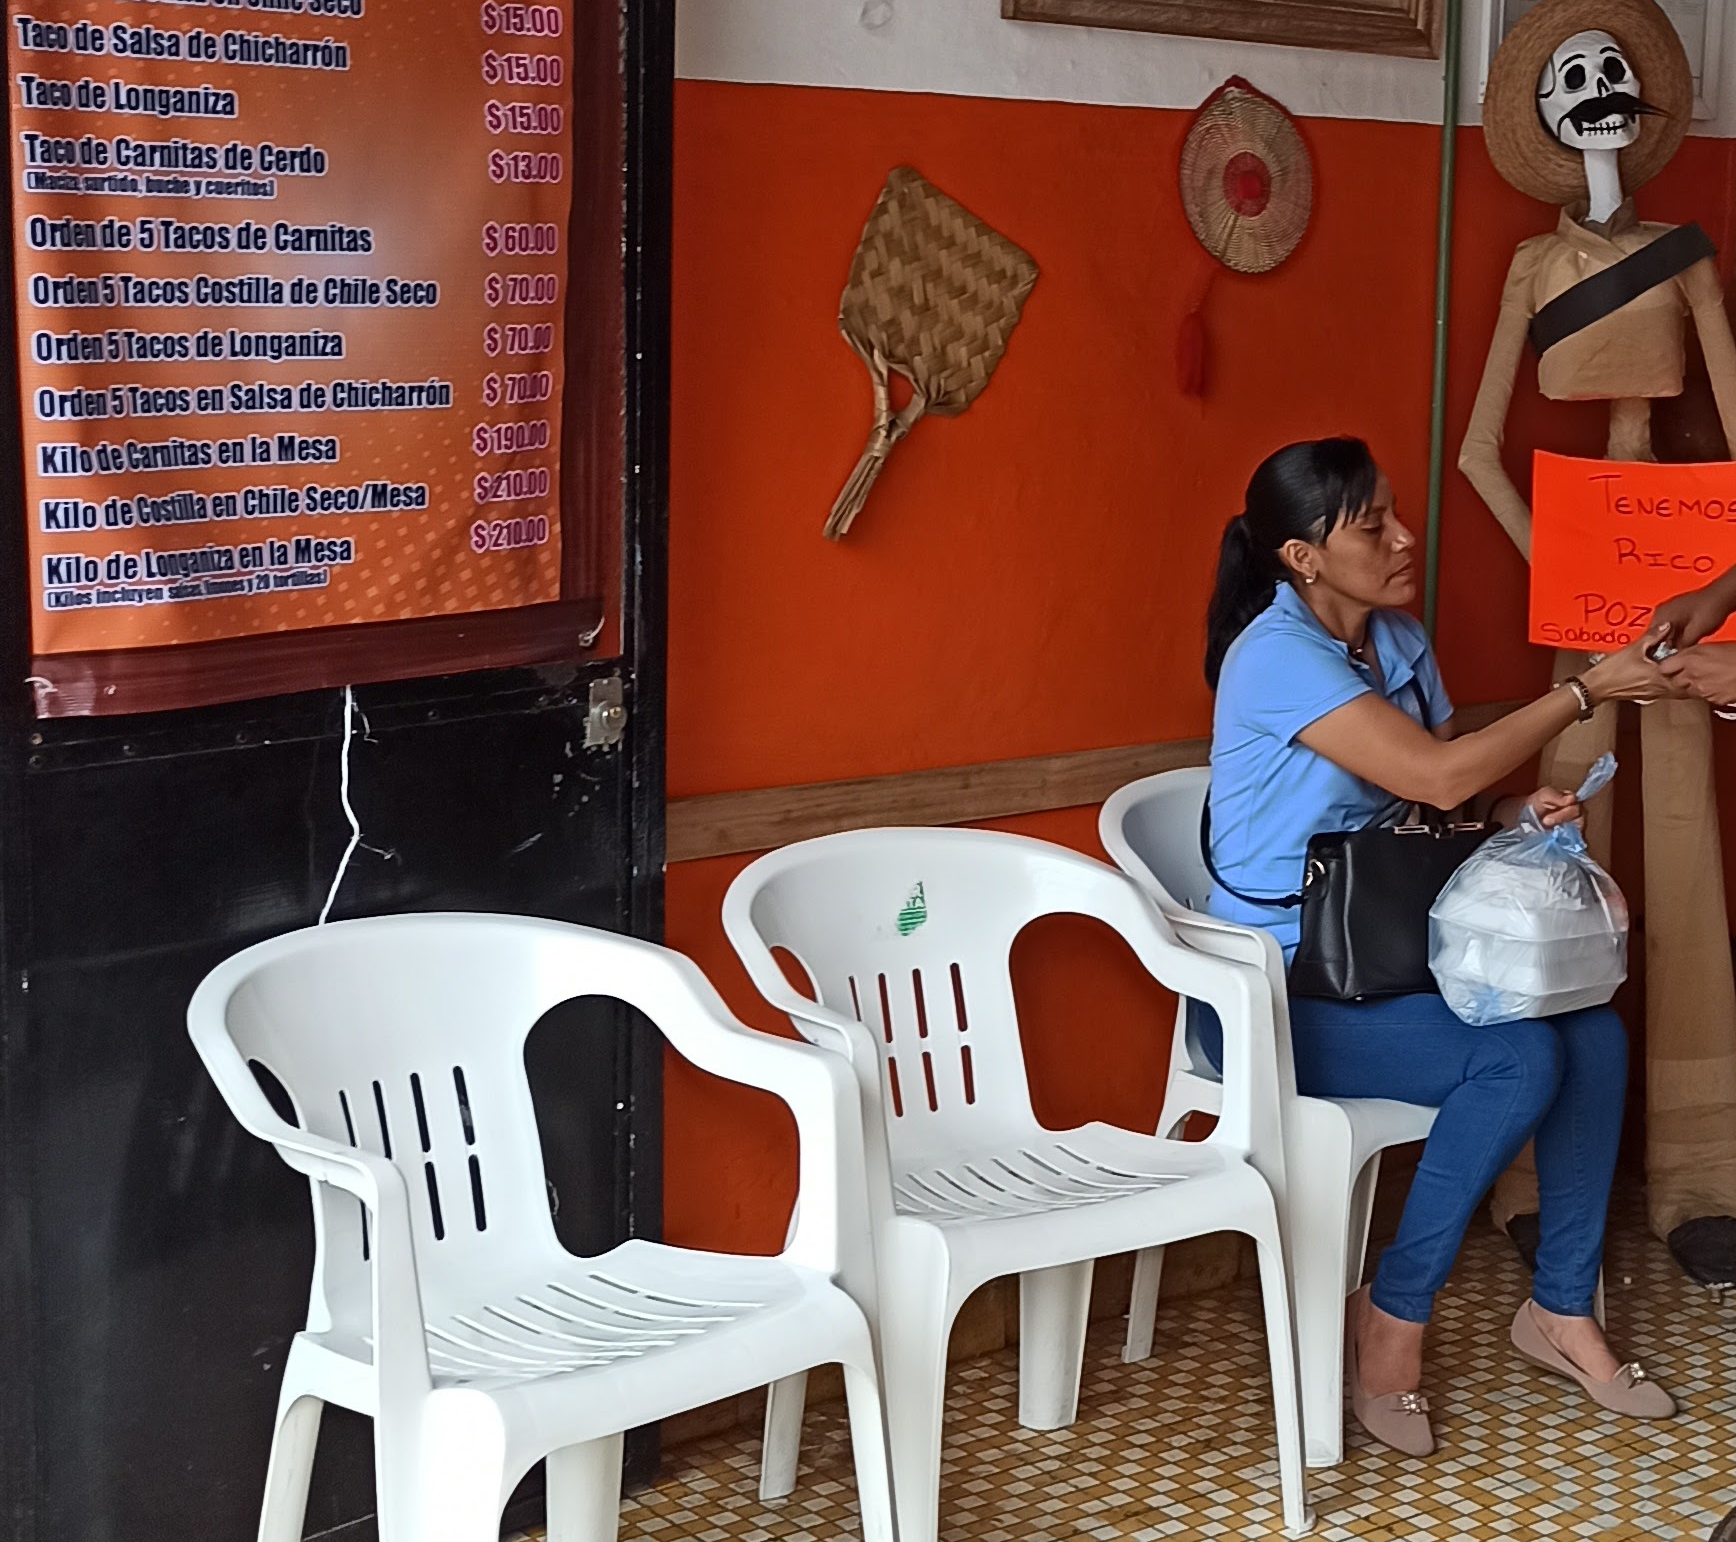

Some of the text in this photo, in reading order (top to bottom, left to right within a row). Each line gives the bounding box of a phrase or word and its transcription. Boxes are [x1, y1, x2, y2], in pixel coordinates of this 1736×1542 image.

[17, 17, 349, 69] Taco de Salsa de Chicharrón
[20, 75, 237, 117] Taco de Longaniza
[23, 133, 327, 176] Taco de Carnitas de Cerdo
[30, 217, 374, 253] Orden de 5 Tacos de Carnitas
[33, 275, 439, 308] Orden 5 Tacos Costilla de Chile Seco
[36, 329, 343, 363] Orden 5 Tacos de Longaniza
[39, 378, 451, 419] Orden 5 Tacos en Salsa de Chicharrón
[42, 434, 338, 475] Kilo de Carnitas en la Mesa
[43, 483, 427, 531] Kilo de Costilla en Chile Seco/Mesa
[46, 537, 353, 585] Kilo de Longaniza en la Mesa
